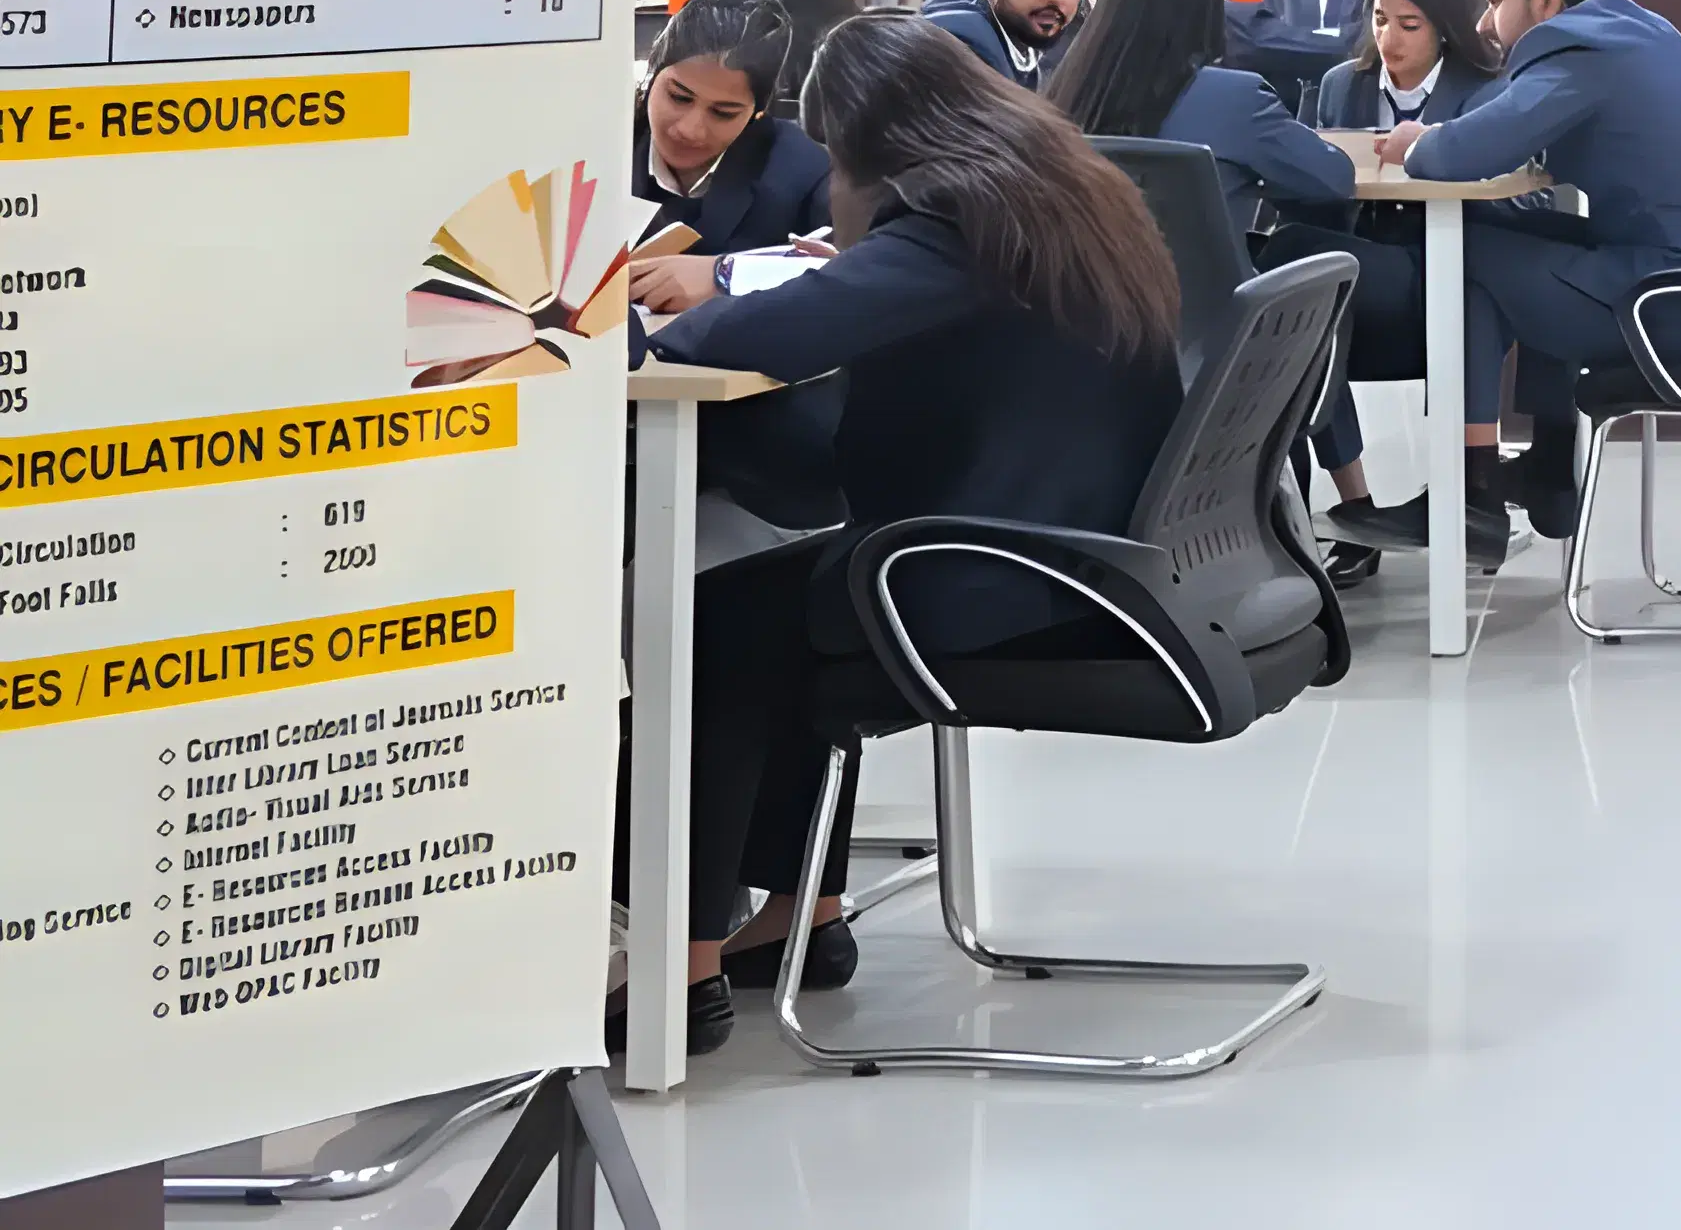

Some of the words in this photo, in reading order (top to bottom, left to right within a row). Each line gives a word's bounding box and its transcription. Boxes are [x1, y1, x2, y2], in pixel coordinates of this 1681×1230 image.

[101, 90, 346, 138] RESOURCES
[278, 402, 491, 459] STATISTICS
[103, 633, 314, 699] FACILITIES
[327, 605, 497, 663] OFFERED
